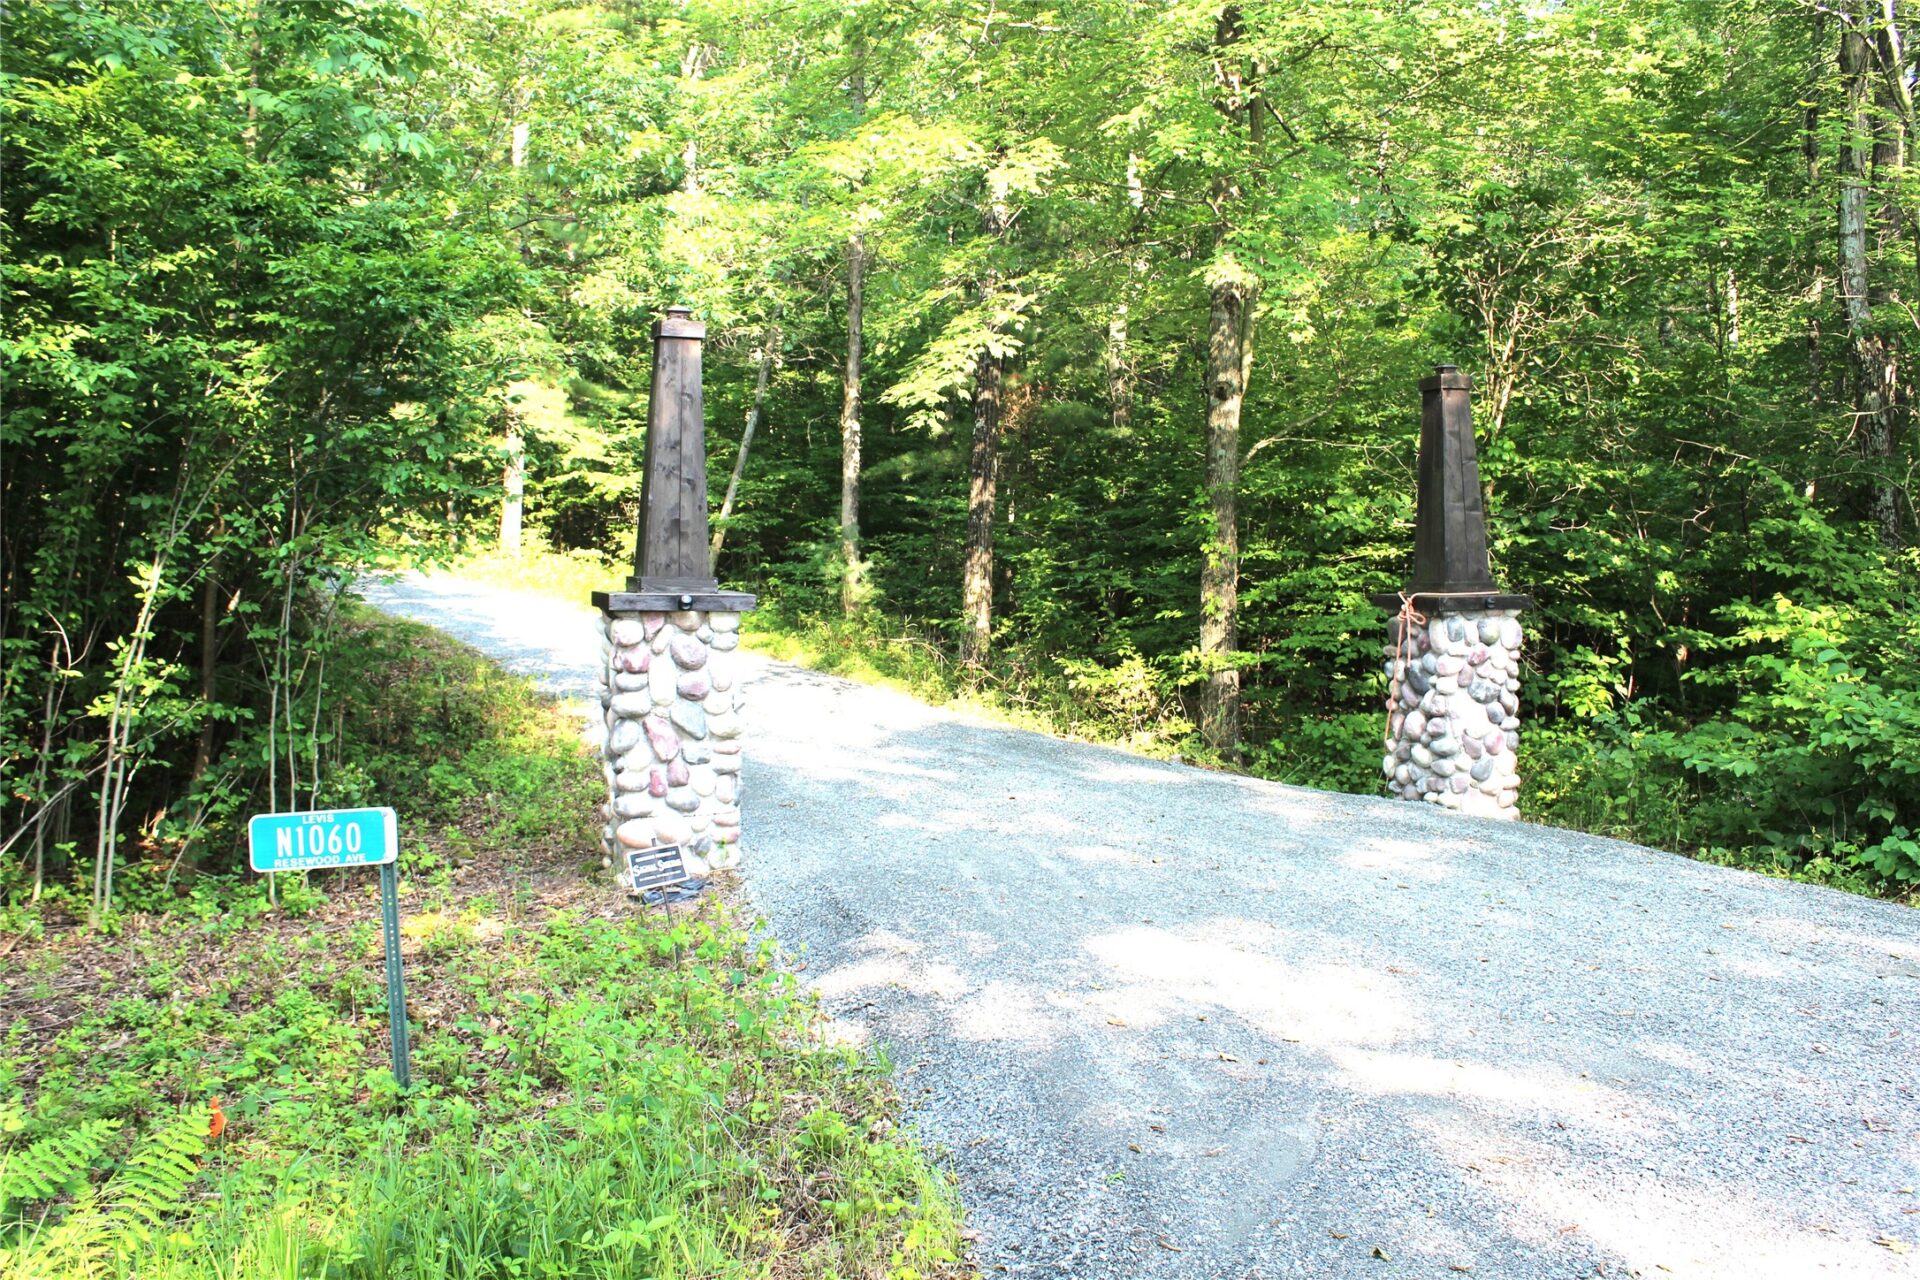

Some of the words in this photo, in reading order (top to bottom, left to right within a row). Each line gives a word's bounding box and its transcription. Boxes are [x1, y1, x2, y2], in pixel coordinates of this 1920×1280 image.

[302, 813, 335, 825] LEVIS
[276, 822, 362, 857] N1060
[345, 853, 367, 863] AVE
